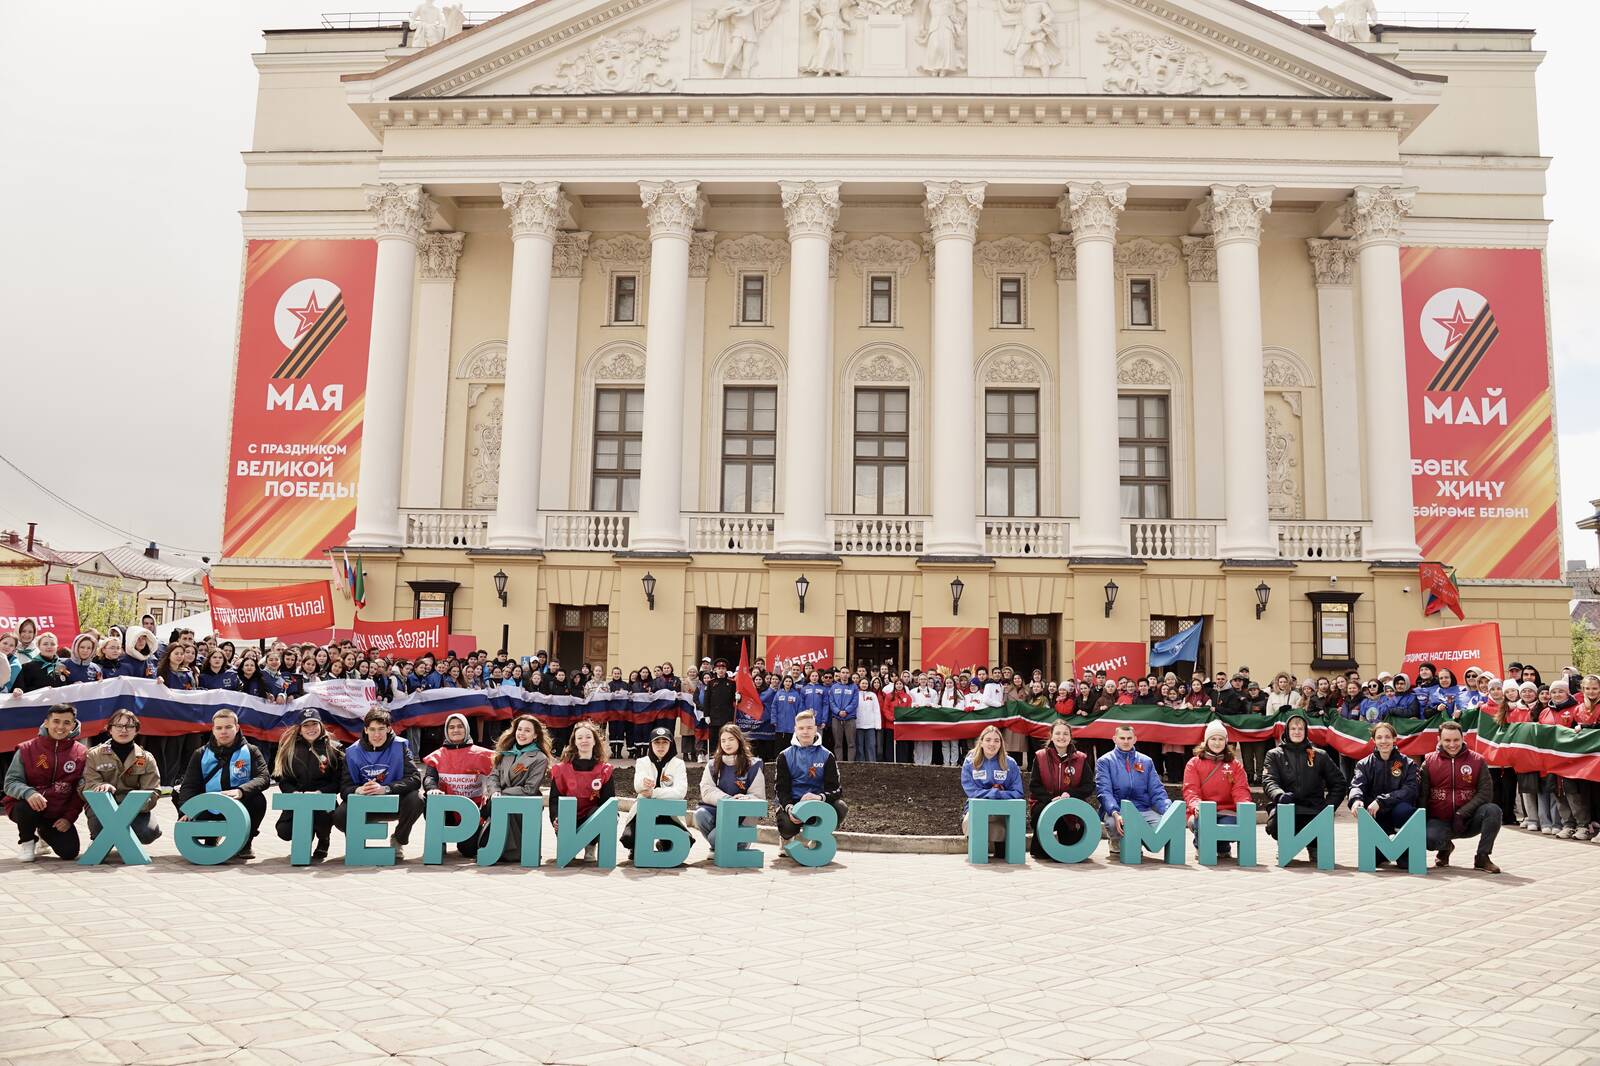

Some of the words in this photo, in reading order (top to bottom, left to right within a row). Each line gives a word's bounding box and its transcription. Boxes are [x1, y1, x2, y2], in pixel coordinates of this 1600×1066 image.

[266, 383, 344, 411] МАЯ
[1423, 387, 1508, 426] МАЙ
[248, 443, 257, 455] С
[261, 443, 347, 456] ПРАЗДНИКОМ
[236, 455, 335, 478] ВЕЛИКОЙ
[1410, 458, 1469, 477] БӨЕК
[1436, 480, 1505, 501] ҖИҢҮ
[1479, 506, 1529, 518] БЕЛӘН!
[287, 595, 326, 618] тыла!
[1430, 649, 1481, 662] НАСЛЕДУЕМ!
[968, 798, 1427, 875] ПОМНИМ
